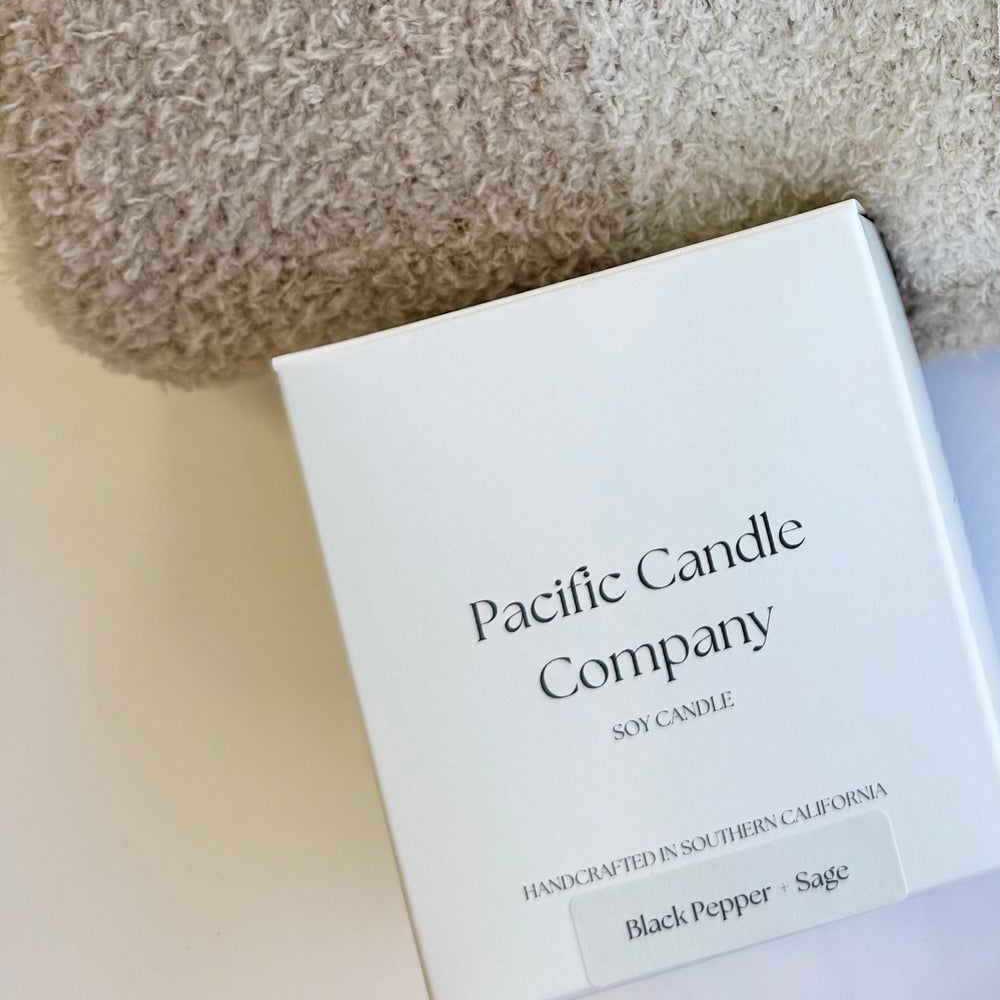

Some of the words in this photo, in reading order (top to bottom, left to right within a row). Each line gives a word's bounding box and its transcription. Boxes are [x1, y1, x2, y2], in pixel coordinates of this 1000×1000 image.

[468, 565, 627, 642] Pacific
[636, 511, 807, 591] Candle
[538, 605, 774, 700] Company
[612, 714, 652, 741] SOY
[655, 691, 735, 728] CANDLE
[523, 850, 657, 901] HANDCRAFTED
[659, 843, 679, 863] IN
[679, 814, 779, 857] SOUTHERN
[780, 781, 889, 827] CALIFORNIA
[625, 905, 689, 941] Black
[690, 883, 772, 922] Pepper
[794, 861, 850, 894] Sage
